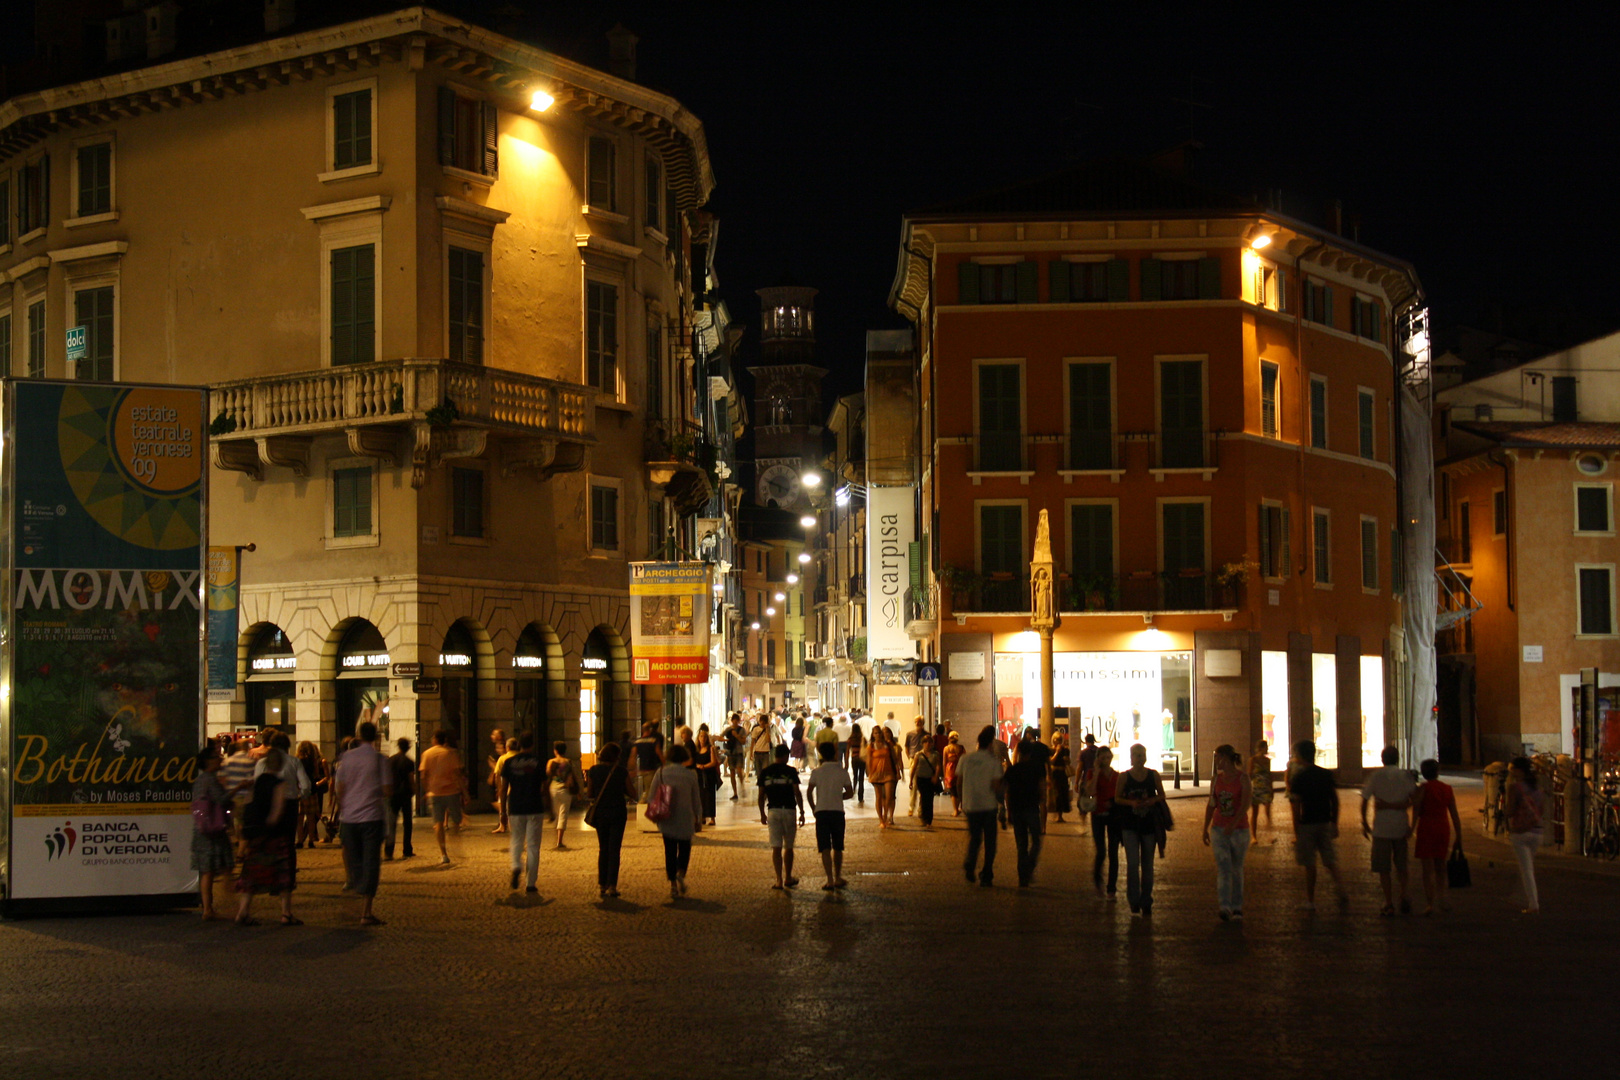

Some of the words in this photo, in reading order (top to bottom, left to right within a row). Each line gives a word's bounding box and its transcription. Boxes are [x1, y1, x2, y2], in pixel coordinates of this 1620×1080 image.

[132, 404, 177, 422] estate
[132, 423, 192, 442] teatrale
[132, 442, 192, 457] veronese
[880, 513, 905, 596] carpisa
[253, 658, 275, 670] LOUIS
[276, 657, 297, 669] VUITT
[343, 655, 366, 667] LOUIS
[367, 654, 390, 666] VUITT
[445, 654, 472, 666] VUITTON
[516, 656, 542, 668] VUITTON
[583, 658, 607, 669] VUITTON
[651, 662, 704, 670] McDonald's
[1032, 668, 1155, 679] itimissimi
[14, 705, 198, 784] Bothanica
[90, 790, 103, 804] by
[107, 789, 141, 802] Moses
[82, 822, 140, 832] BANCA
[82, 833, 168, 844] POPOLARE
[82, 846, 97, 856] DI
[103, 845, 171, 855] VERONA
[82, 857, 107, 865] GRUPPO
[108, 857, 134, 865] BANCO
[136, 856, 171, 865] POPOLARE
